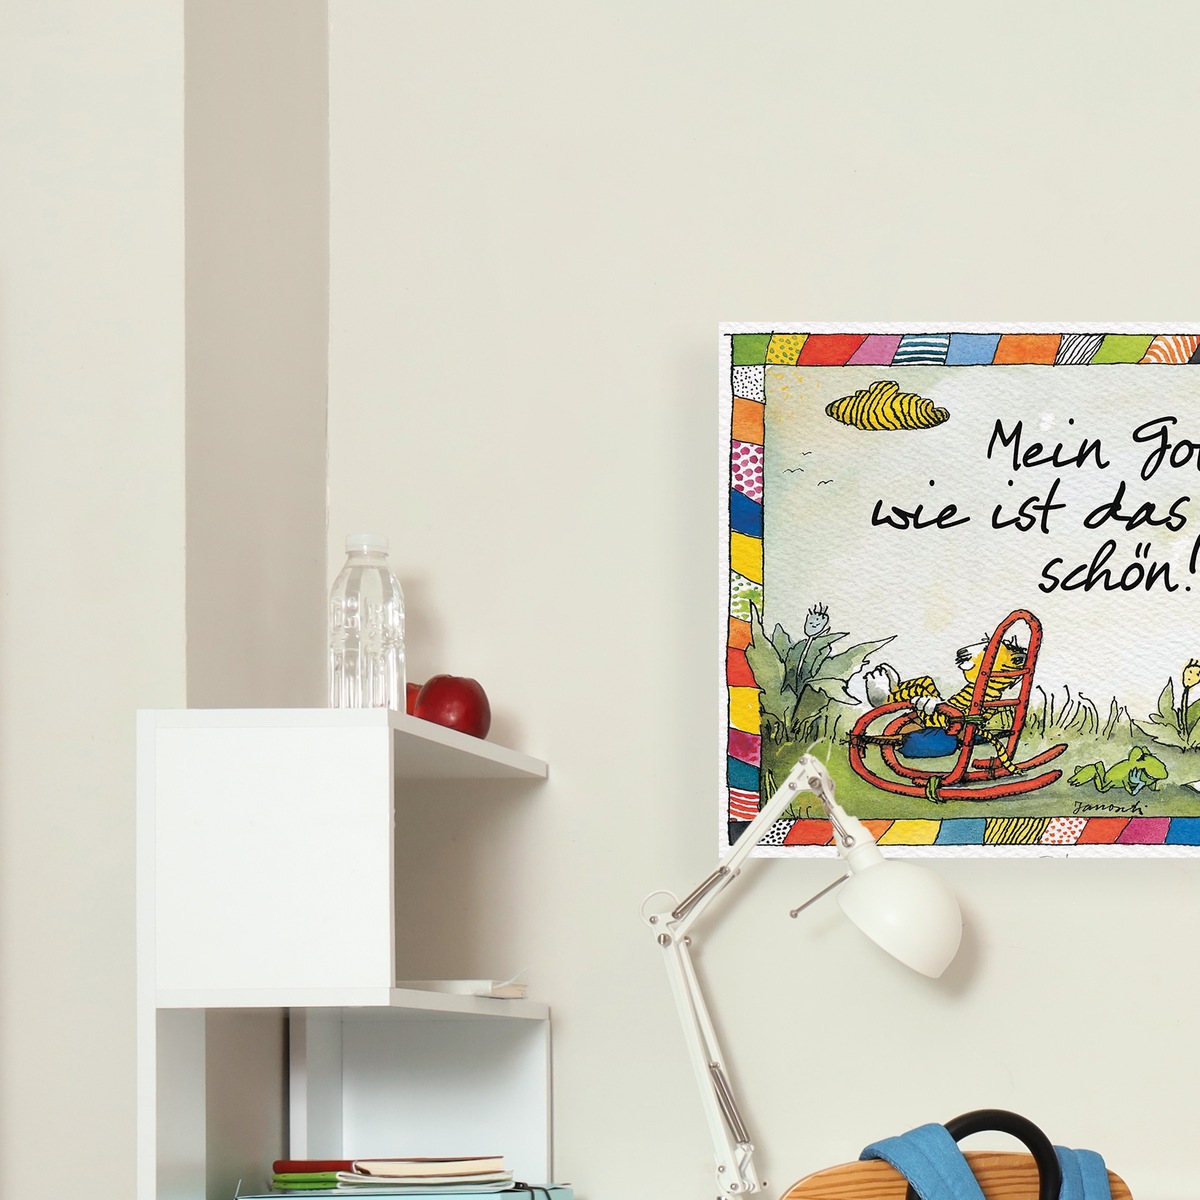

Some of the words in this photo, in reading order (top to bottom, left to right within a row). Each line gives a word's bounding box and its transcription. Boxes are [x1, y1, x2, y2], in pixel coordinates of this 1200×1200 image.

[986, 417, 1111, 472] Mein
[871, 479, 971, 530] wie
[991, 479, 1067, 535] ist
[1083, 480, 1191, 532] das
